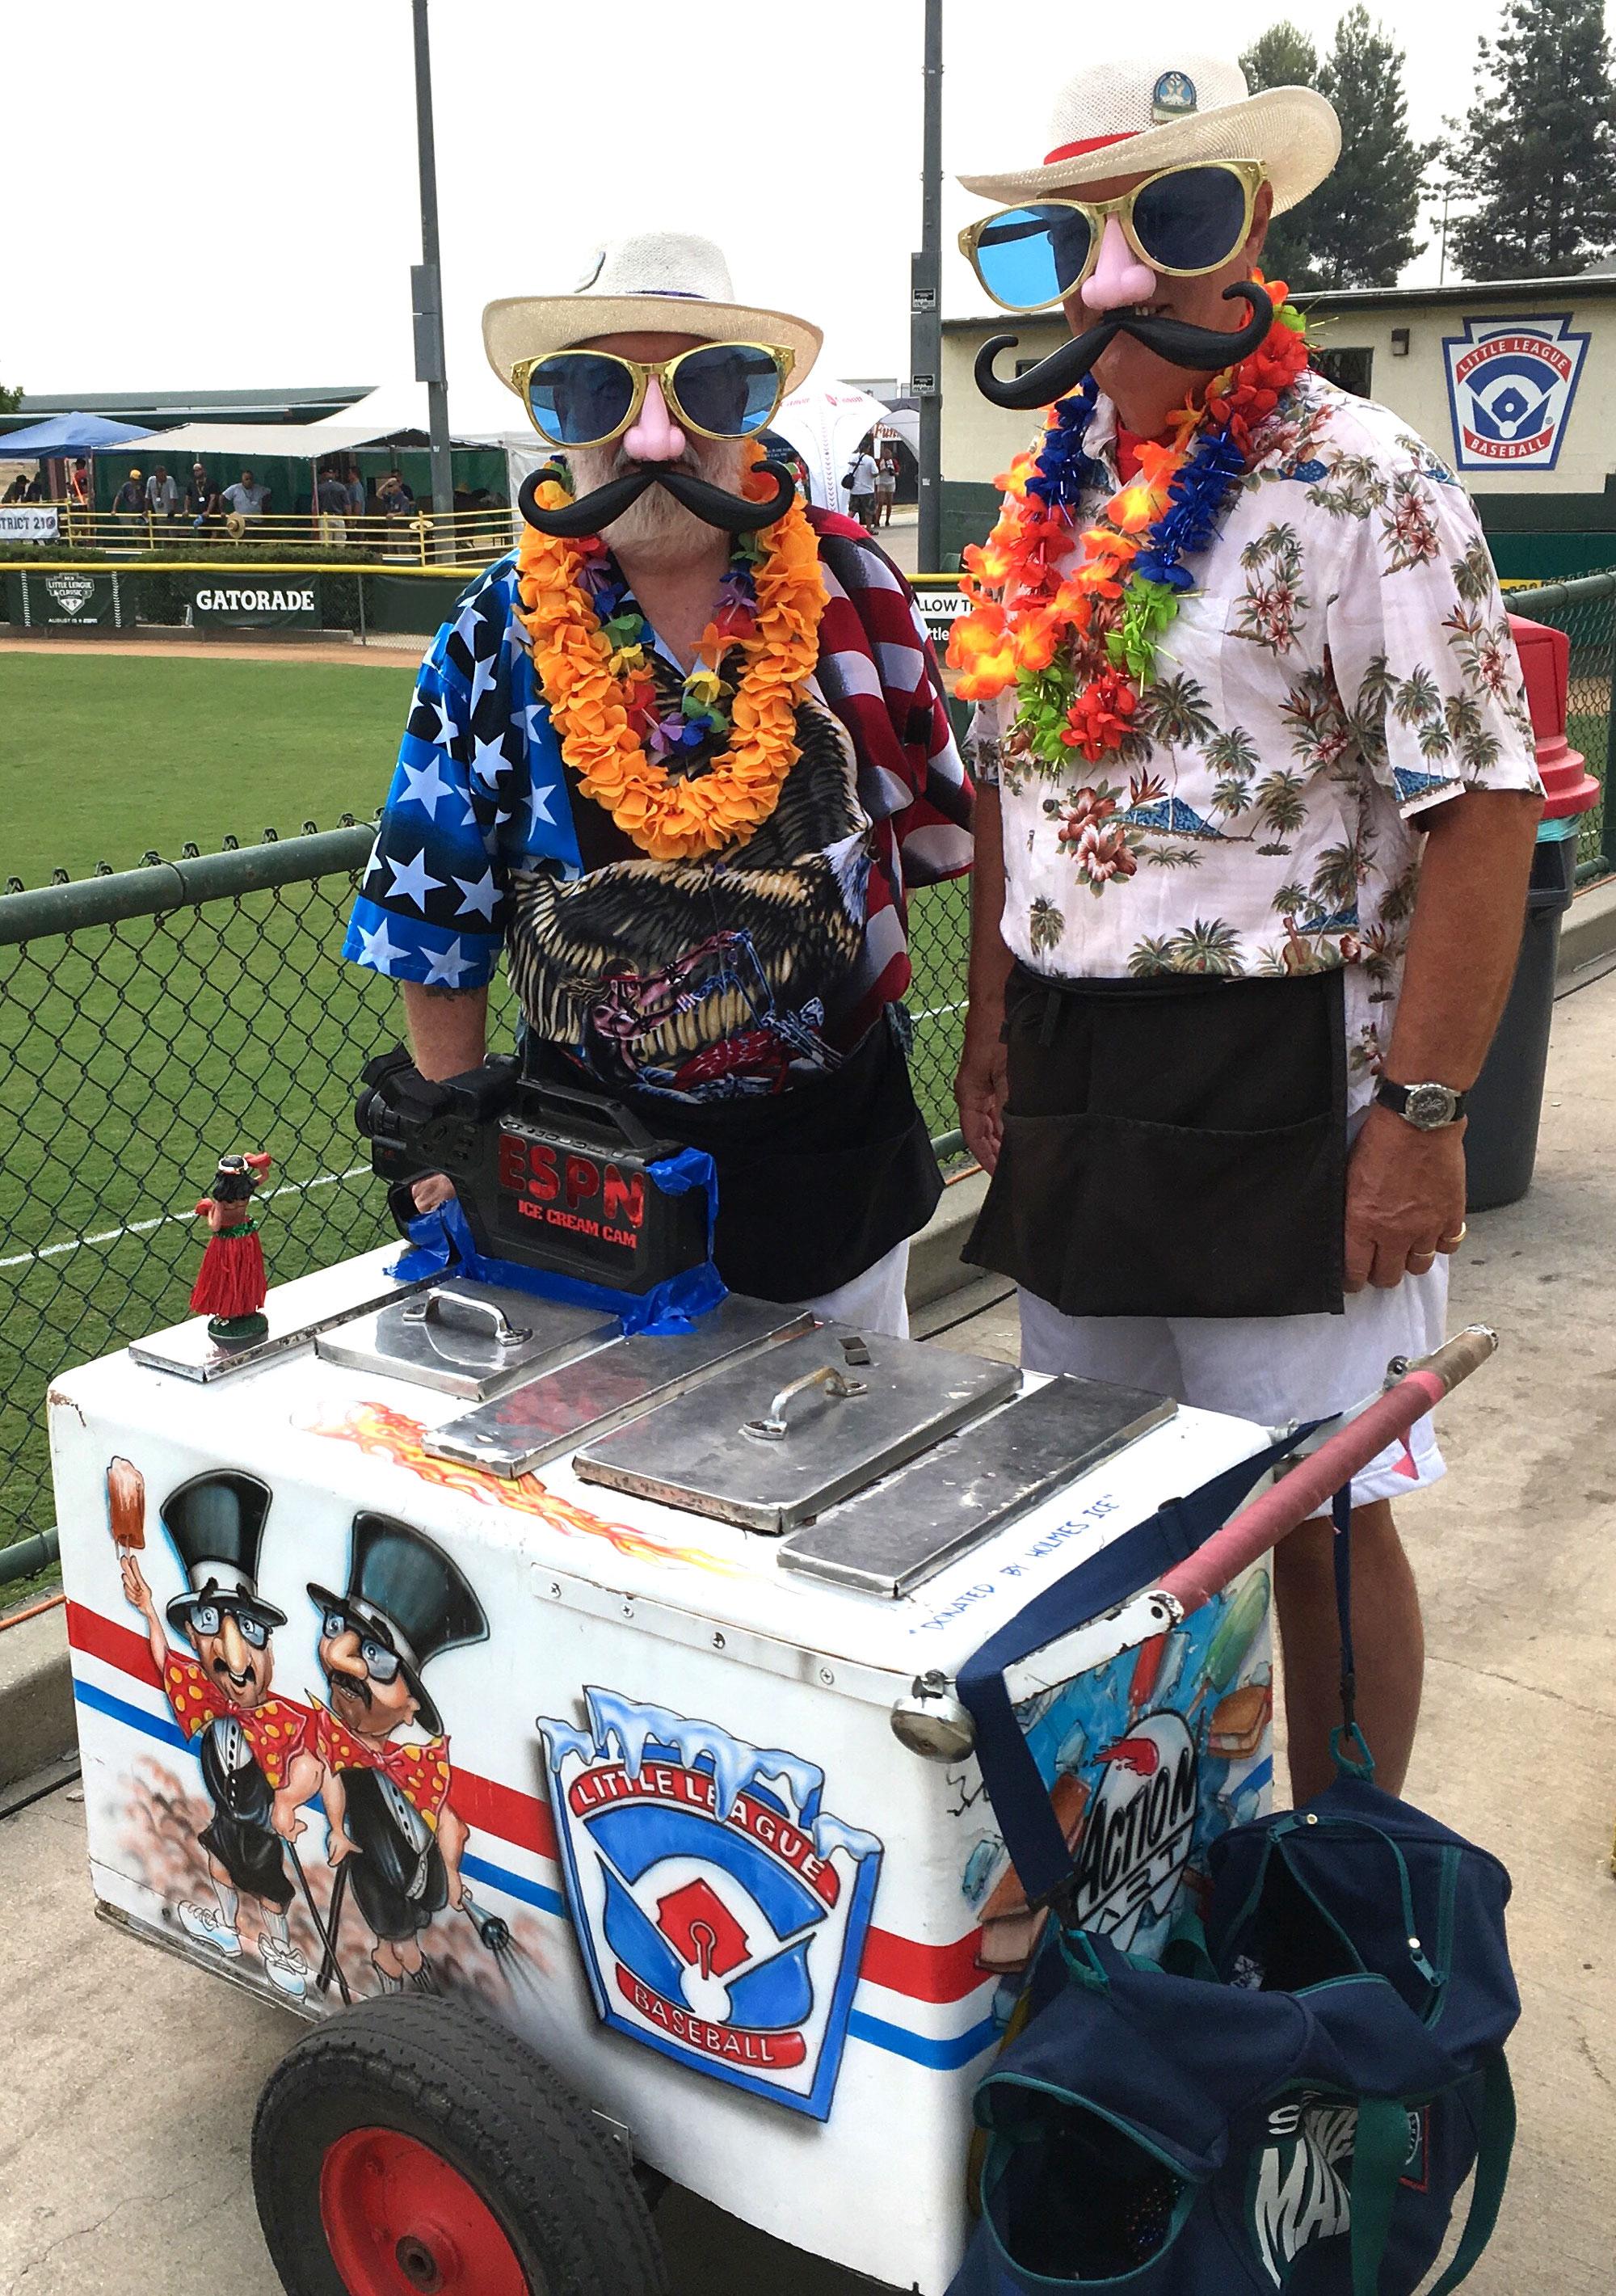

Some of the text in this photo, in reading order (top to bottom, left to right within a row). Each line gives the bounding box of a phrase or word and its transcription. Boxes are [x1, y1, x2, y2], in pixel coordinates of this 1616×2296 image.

[1459, 339, 1568, 373] LITTLE LEAGUE
[1471, 439, 1545, 457] BASEBALL
[0, 517, 30, 530] TRICT
[196, 590, 315, 611] GATORADE
[499, 1133, 645, 1228] ESPN
[518, 1199, 637, 1249] ICE CREAM CAM
[999, 1562, 1029, 1577] BY
[1025, 1521, 1090, 1558] HOLMES
[577, 1769, 826, 1882] LITTLE LEAGUE
[1080, 1746, 1198, 1905] ACTION
[634, 1984, 775, 2062] BASEBALL
